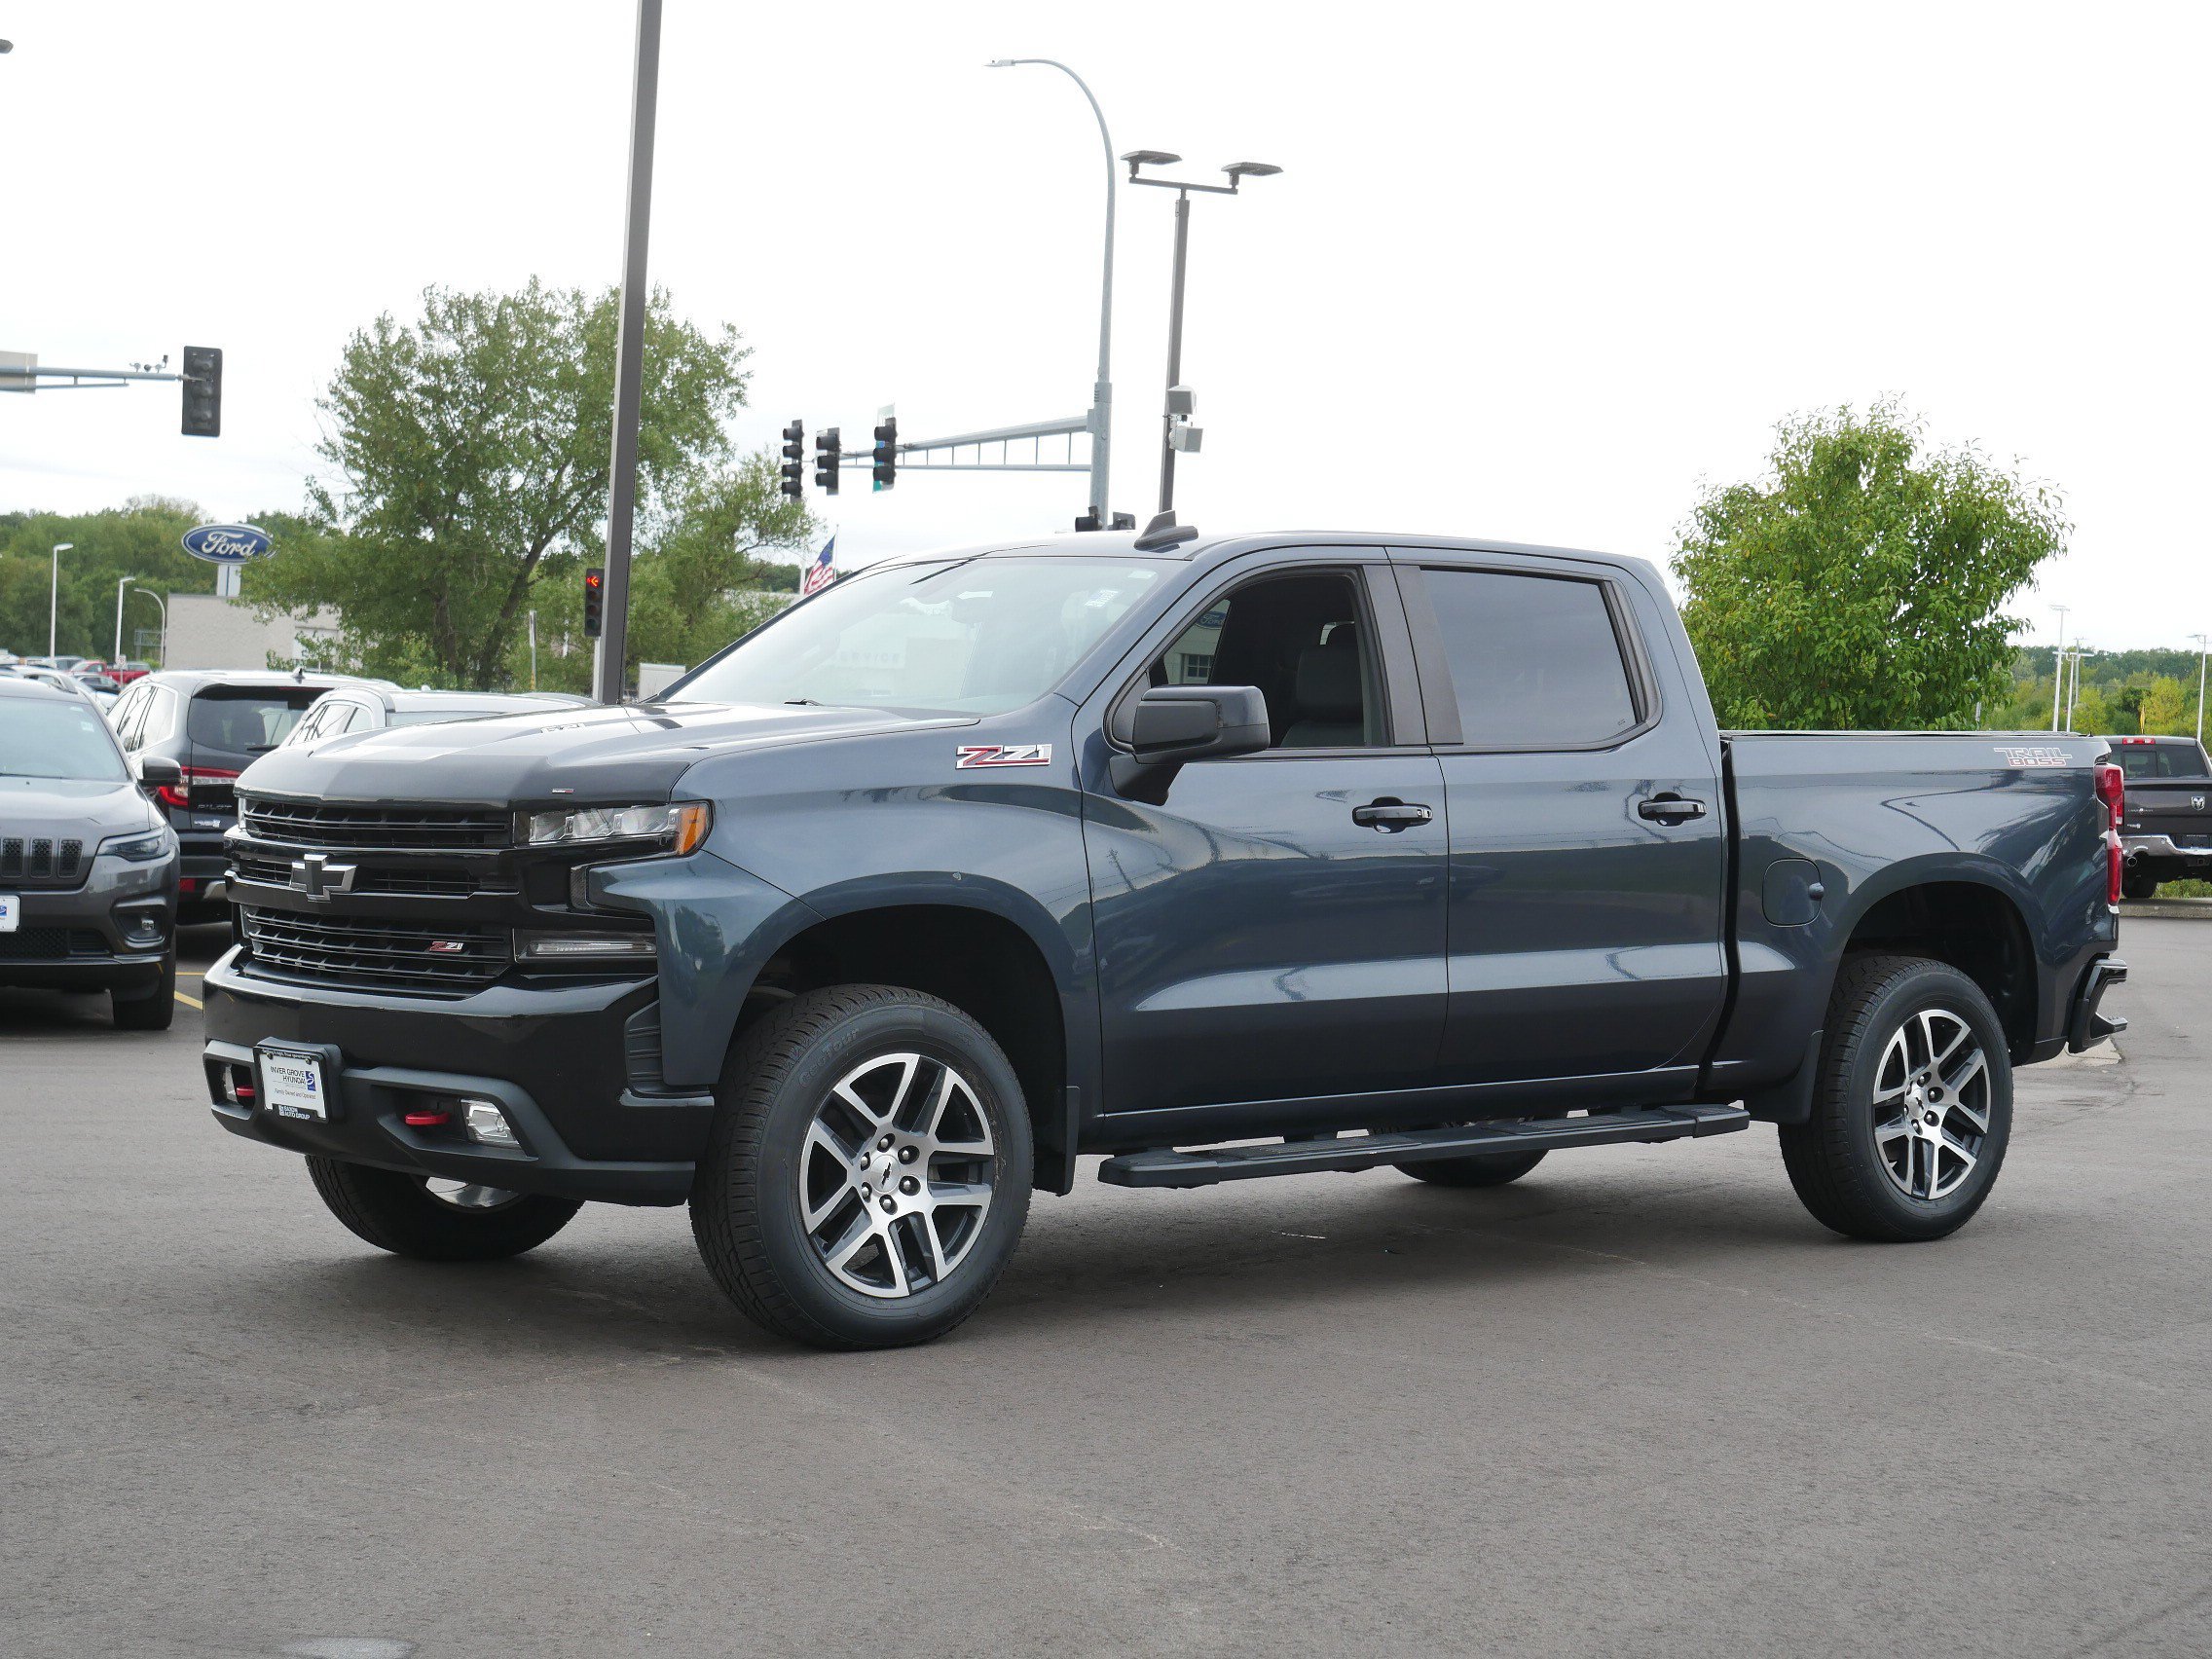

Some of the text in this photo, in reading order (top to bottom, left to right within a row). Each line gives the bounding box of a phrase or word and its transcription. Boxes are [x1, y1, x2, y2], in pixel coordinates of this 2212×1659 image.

[202, 531, 257, 556] Ford
[955, 744, 1051, 769] Z71
[1993, 747, 2073, 758] TRAIL
[2008, 757, 2066, 766] BOSS
[429, 940, 464, 953] Z71
[270, 1066, 286, 1075] INVER
[282, 1076, 306, 1085] HYUNDAI
